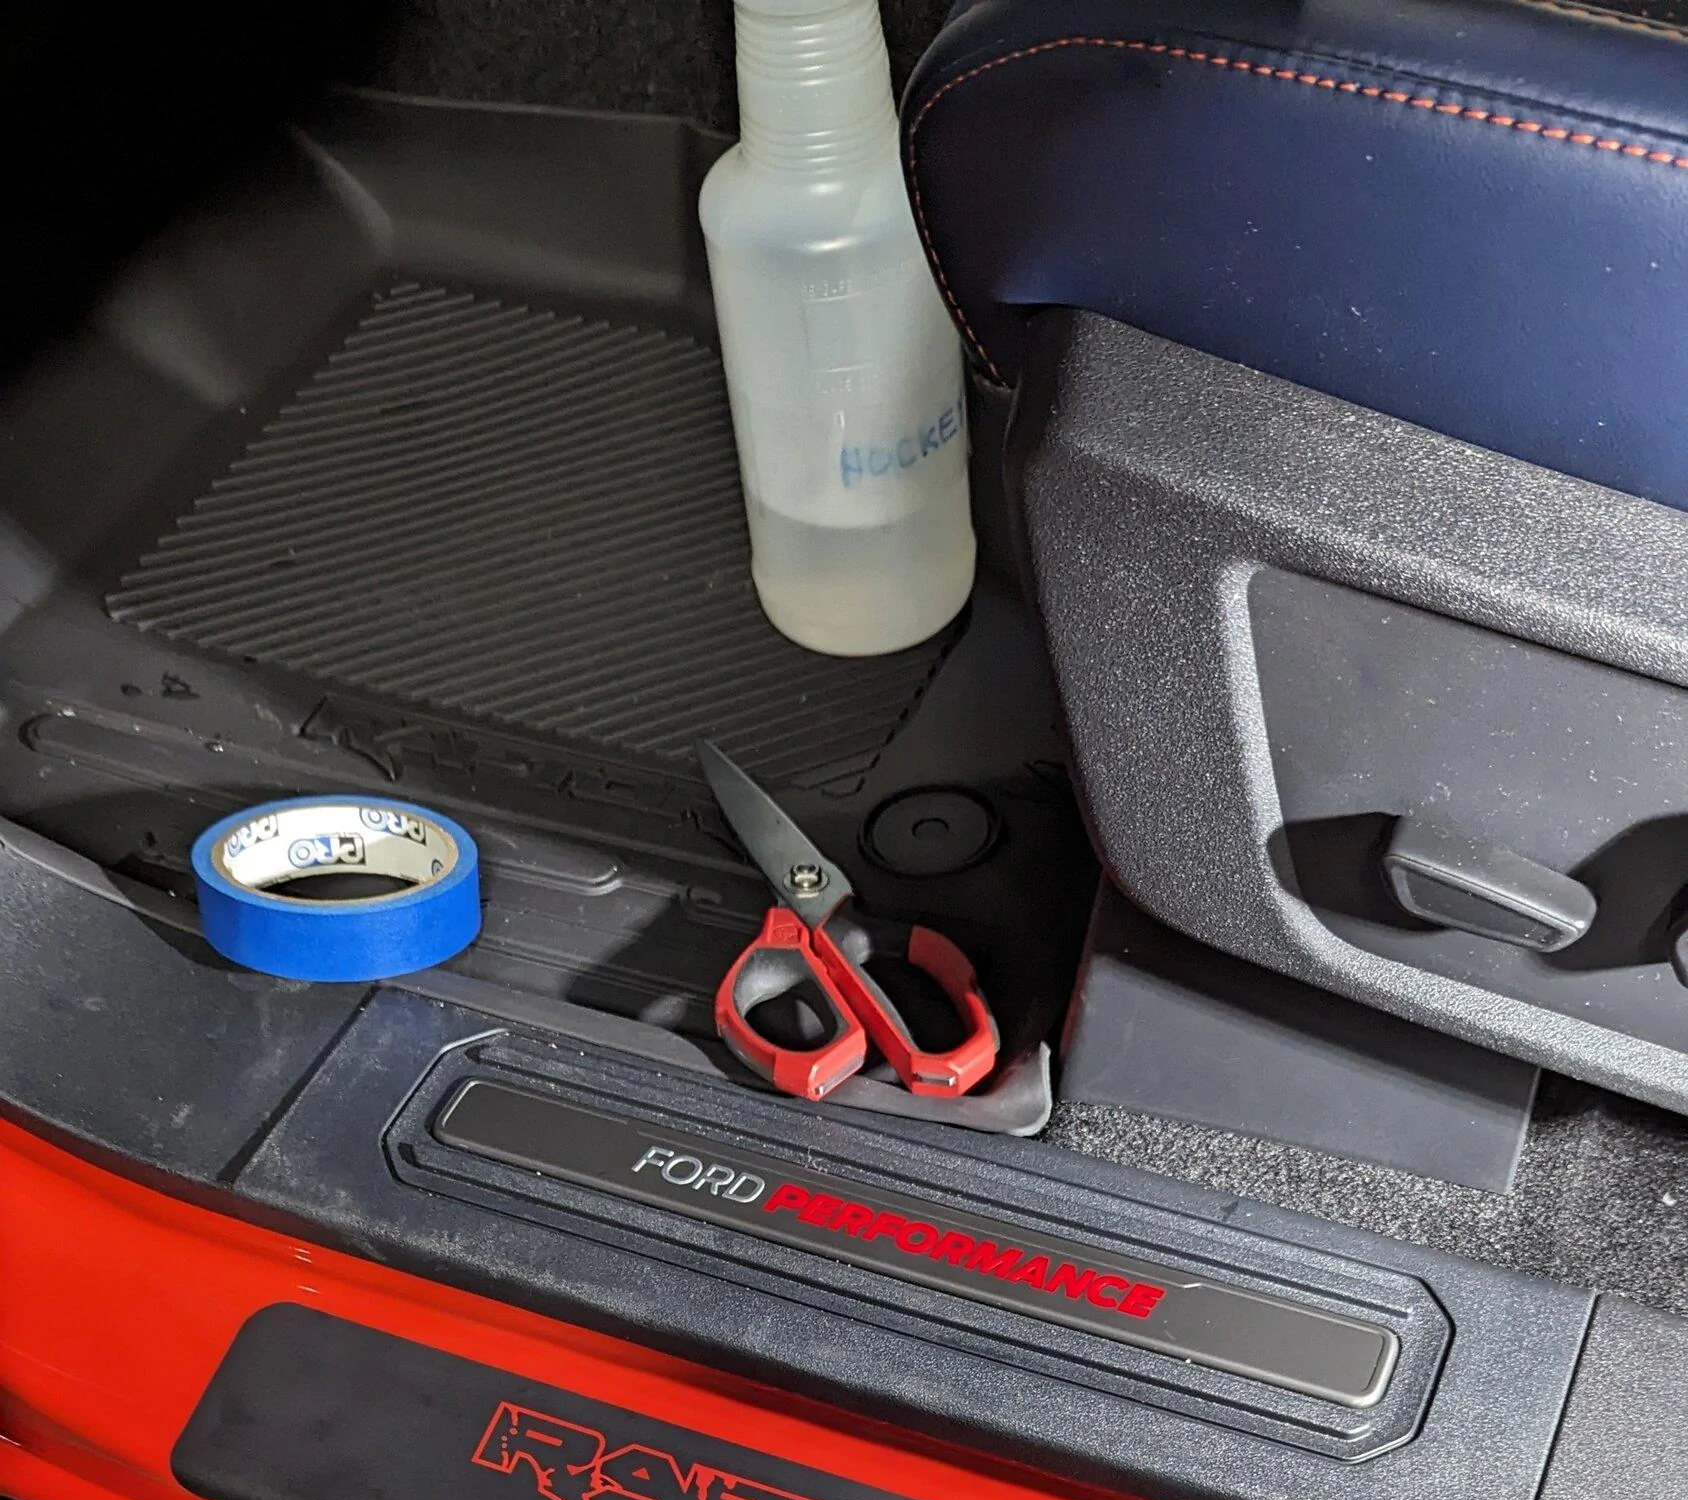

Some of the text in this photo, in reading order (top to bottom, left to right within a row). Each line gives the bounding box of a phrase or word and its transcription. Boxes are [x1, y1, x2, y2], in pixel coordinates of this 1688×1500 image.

[359, 808, 427, 846] PRO
[289, 836, 366, 869] PRO
[632, 1146, 1165, 1318] FORD PERFORMANCE
